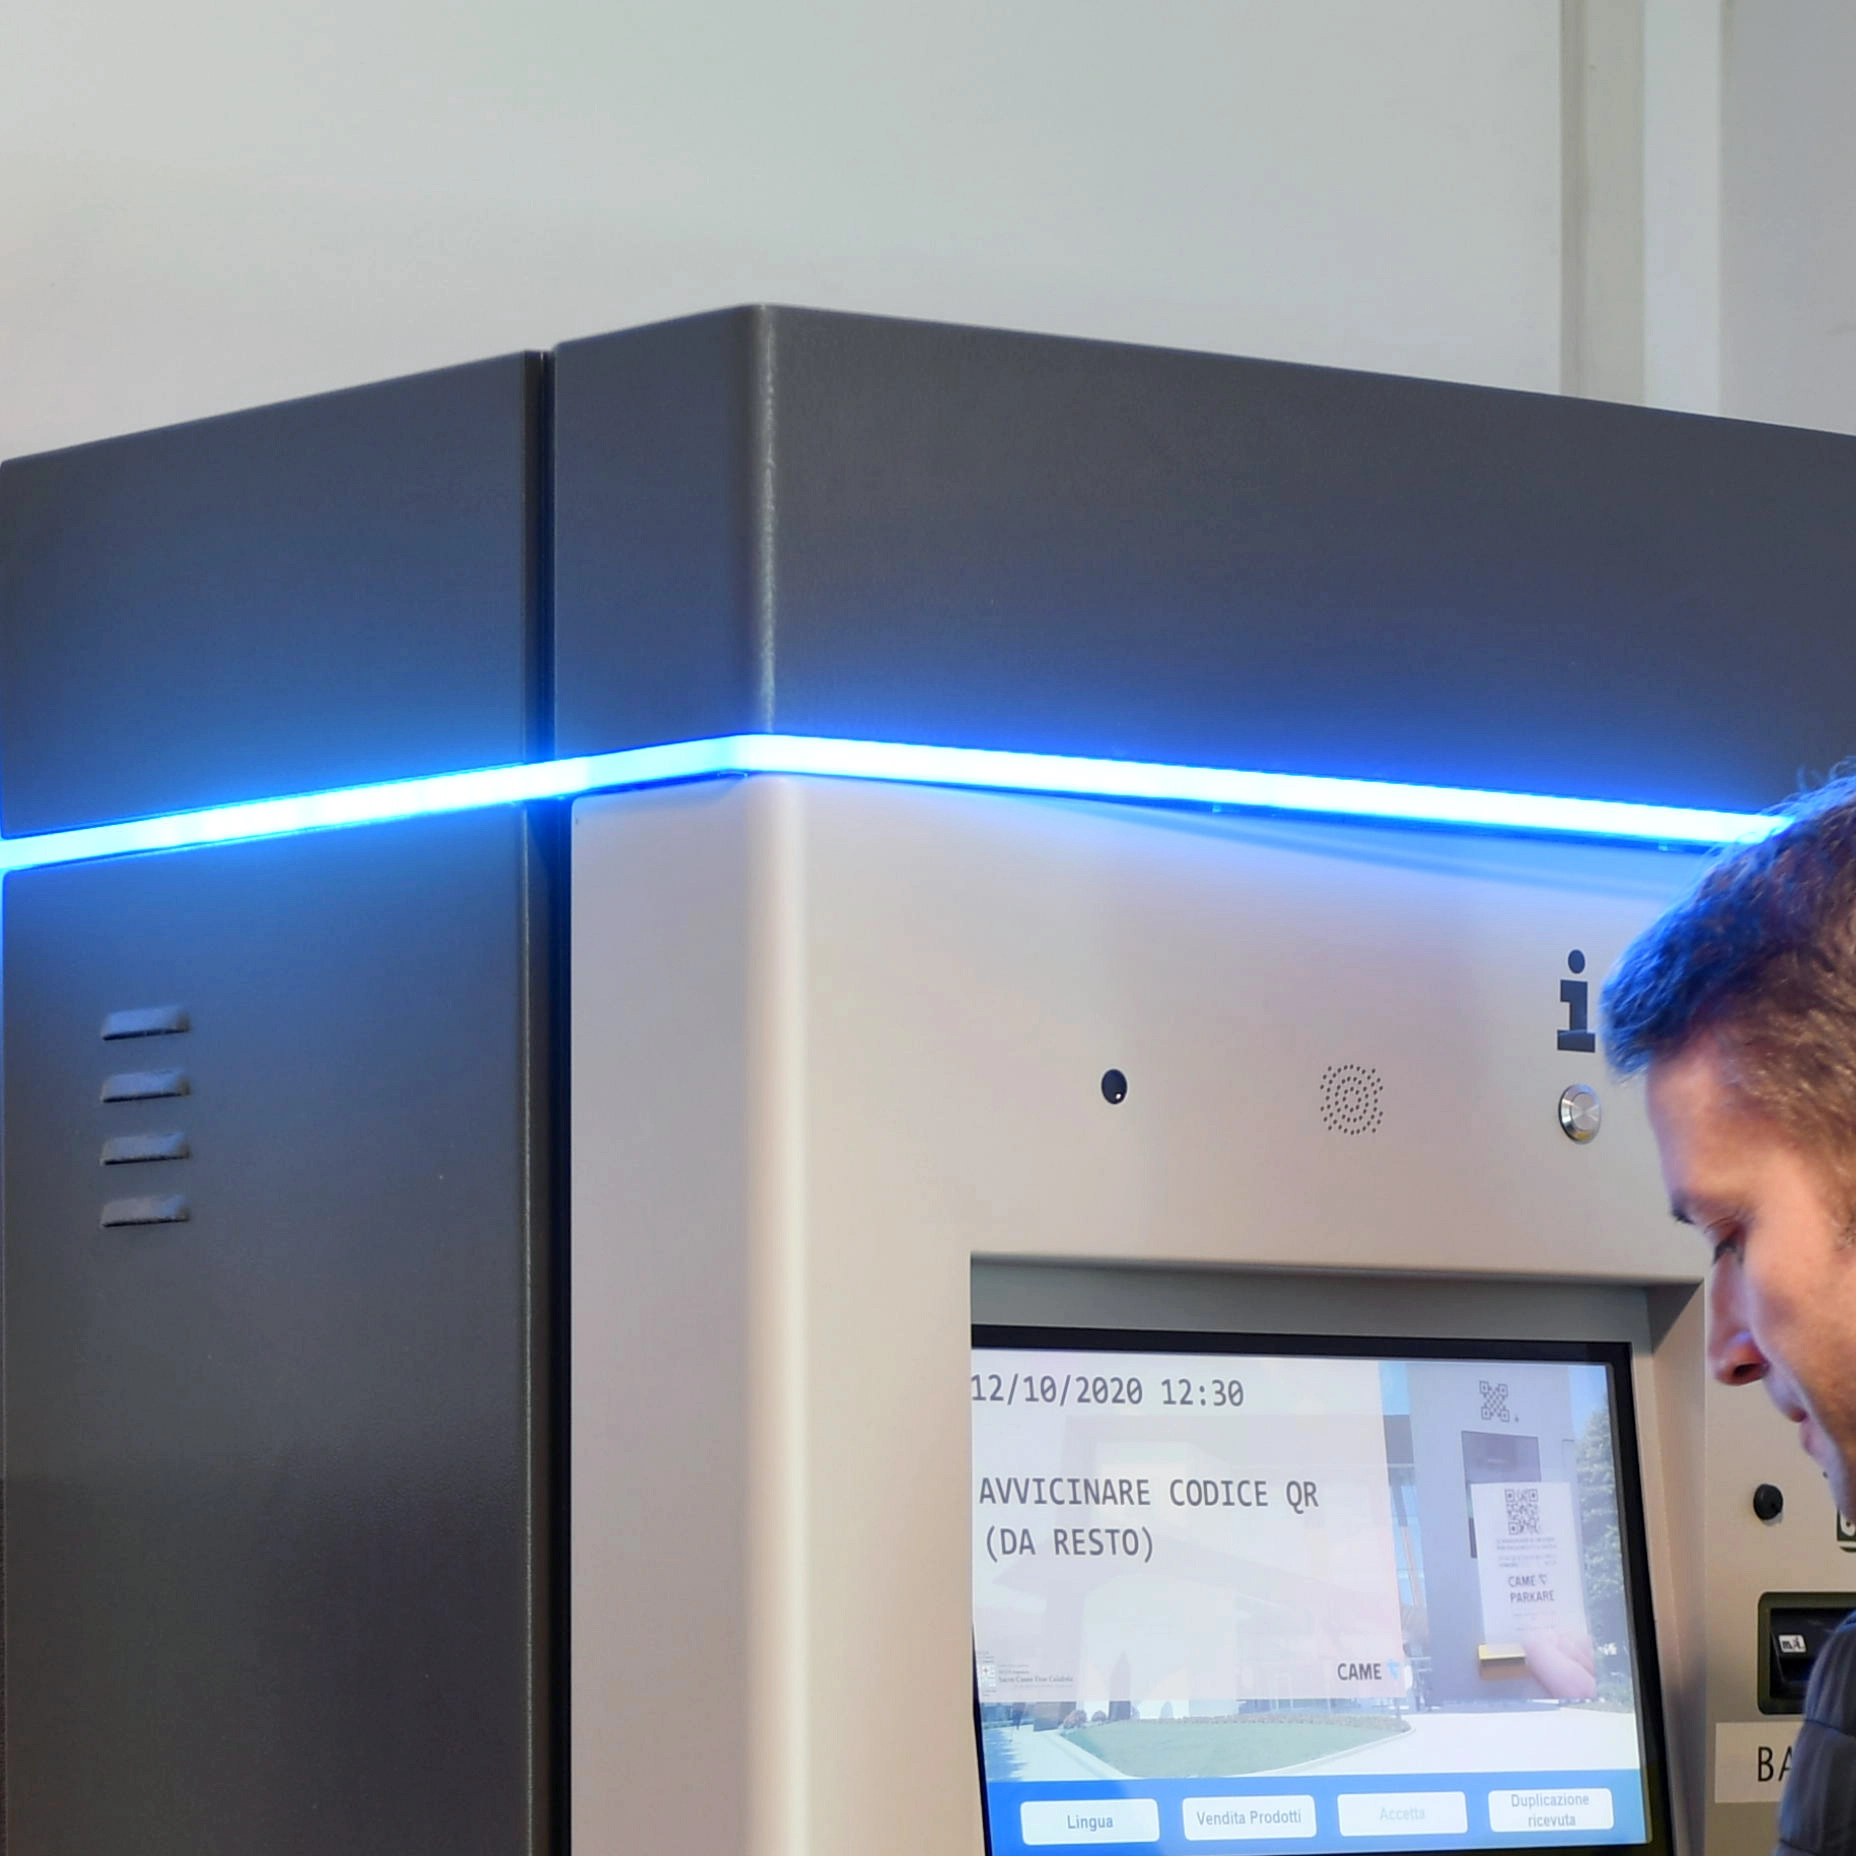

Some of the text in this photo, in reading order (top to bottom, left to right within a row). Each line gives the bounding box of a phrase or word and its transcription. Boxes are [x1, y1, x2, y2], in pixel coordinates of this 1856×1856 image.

[971, 1373, 1245, 1407] 12/10/2020 12:30
[979, 1477, 1319, 1514] AVVICINARE CODICE QR
[986, 1526, 1153, 1563] (DA RESTO)
[1337, 1662, 1382, 1680] CAME
[1511, 1793, 1589, 1811] Duplicazione
[1197, 1808, 1302, 1826] Vendita Prodotti
[1380, 1806, 1425, 1822] Accetta
[1528, 1813, 1576, 1828] ricevuta
[1067, 1814, 1114, 1833] Lingua
